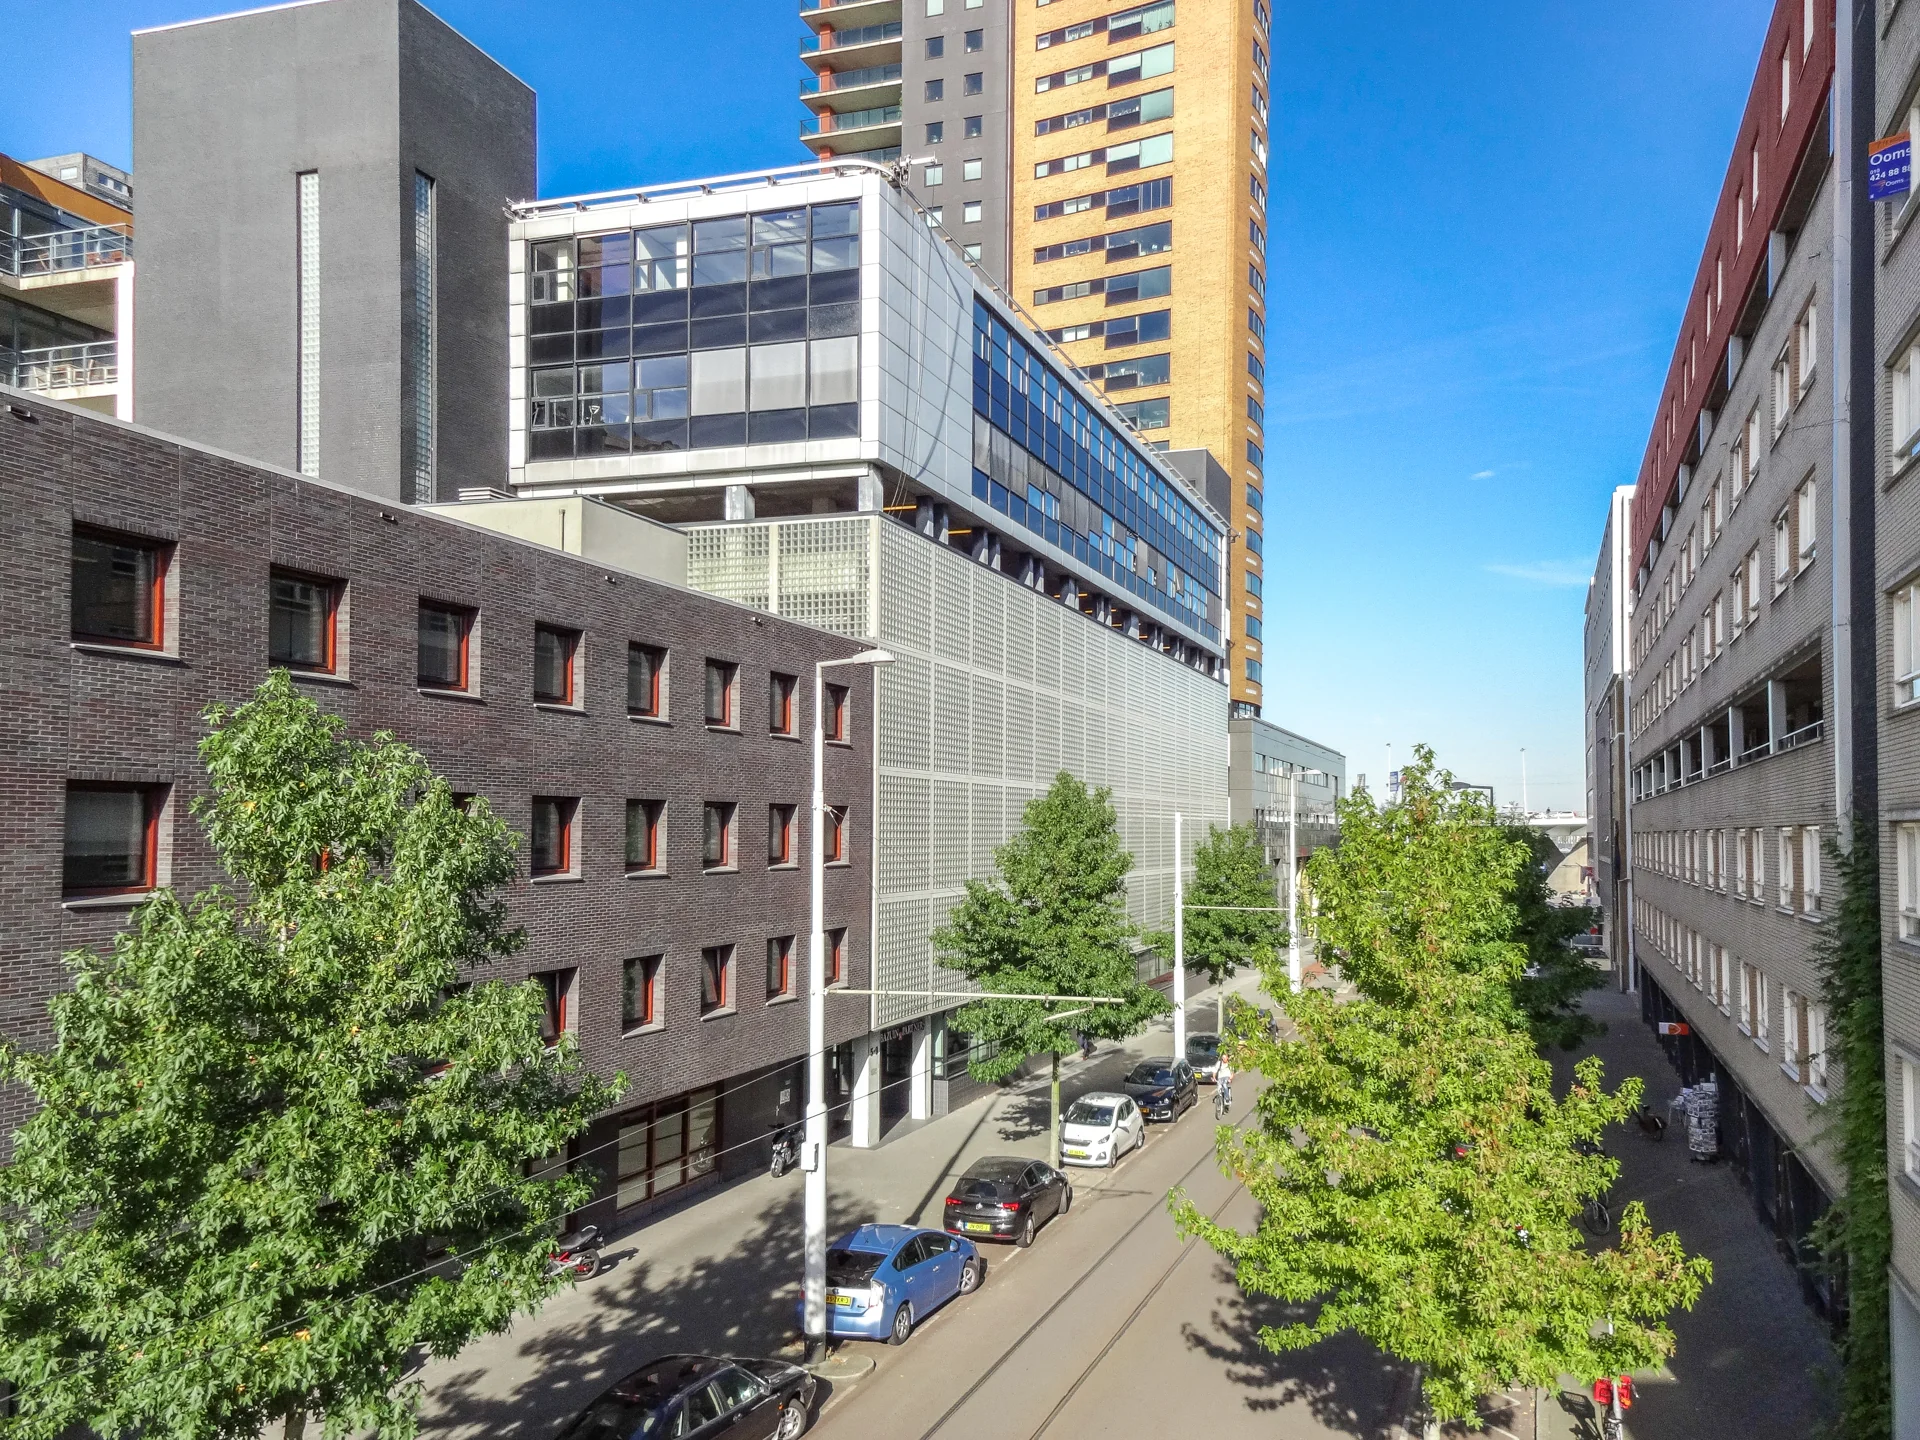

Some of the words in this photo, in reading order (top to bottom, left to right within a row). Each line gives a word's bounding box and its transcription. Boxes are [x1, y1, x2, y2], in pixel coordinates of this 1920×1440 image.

[1870, 148, 1911, 165] Ooms
[1870, 171, 1886, 181] 424
[1888, 168, 1899, 176] 88
[1886, 178, 1904, 186] Ooms
